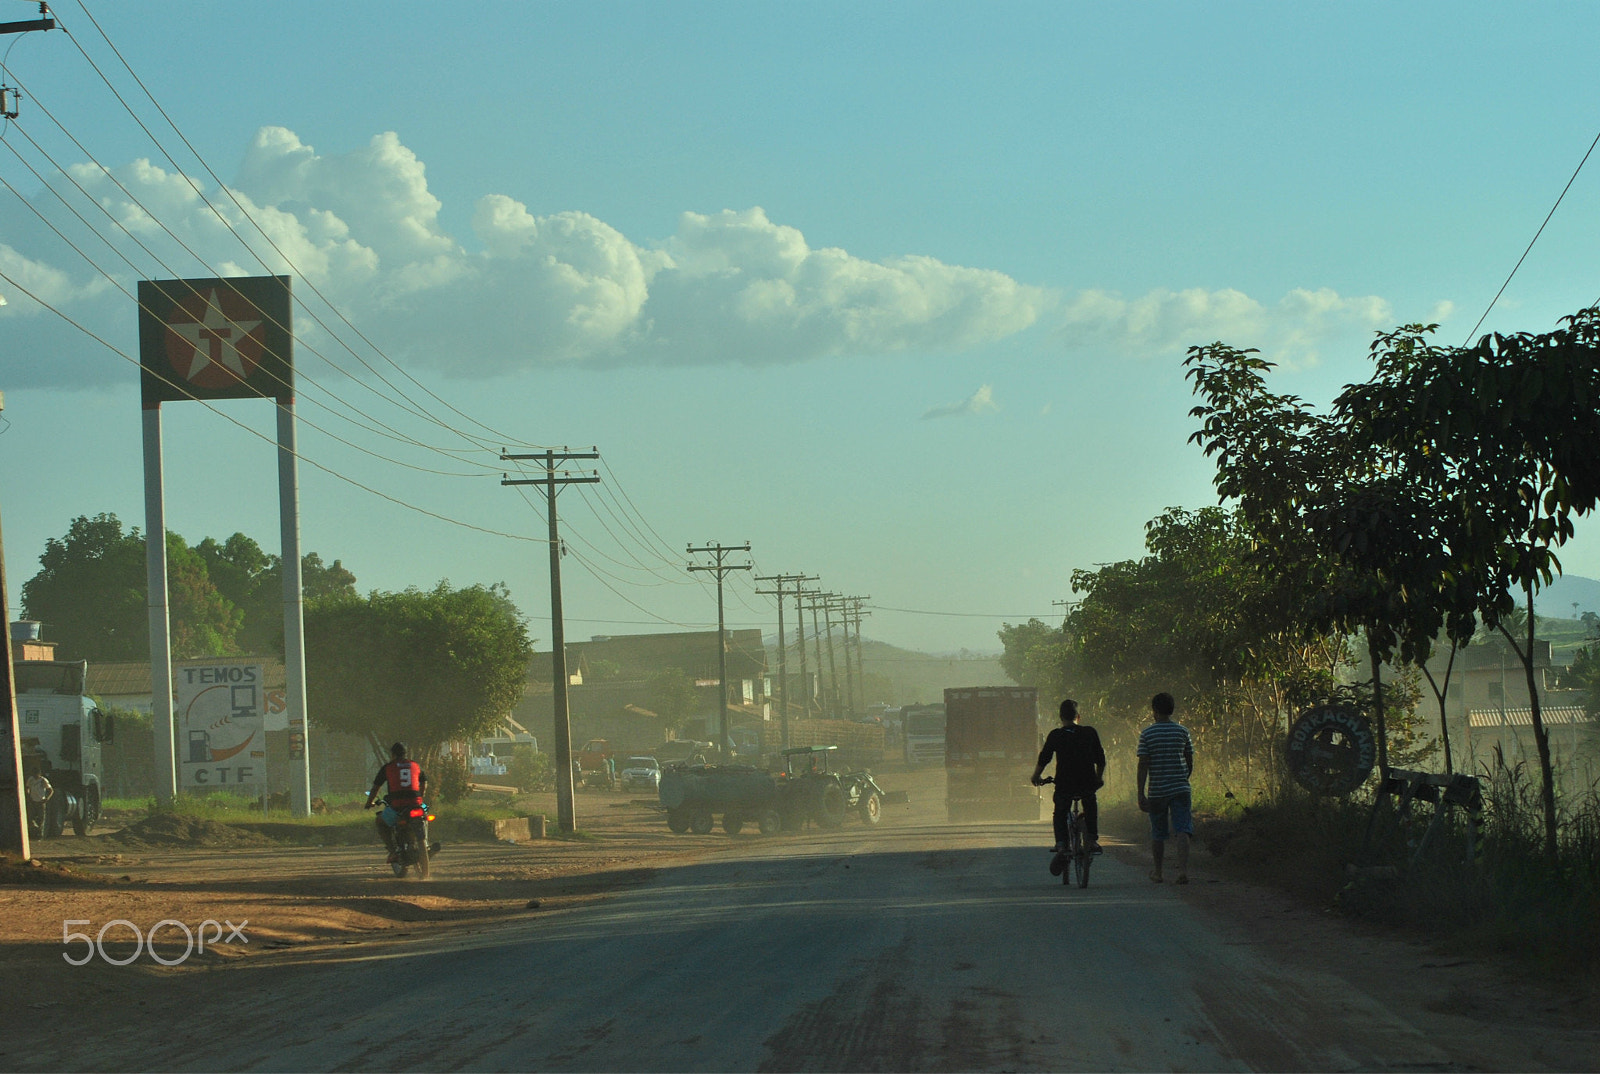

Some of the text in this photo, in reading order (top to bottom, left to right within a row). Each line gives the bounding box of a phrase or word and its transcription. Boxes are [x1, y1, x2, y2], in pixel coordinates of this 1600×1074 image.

[199, 328, 231, 366] T
[184, 666, 257, 684] TEMOS
[400, 768, 411, 787] 9
